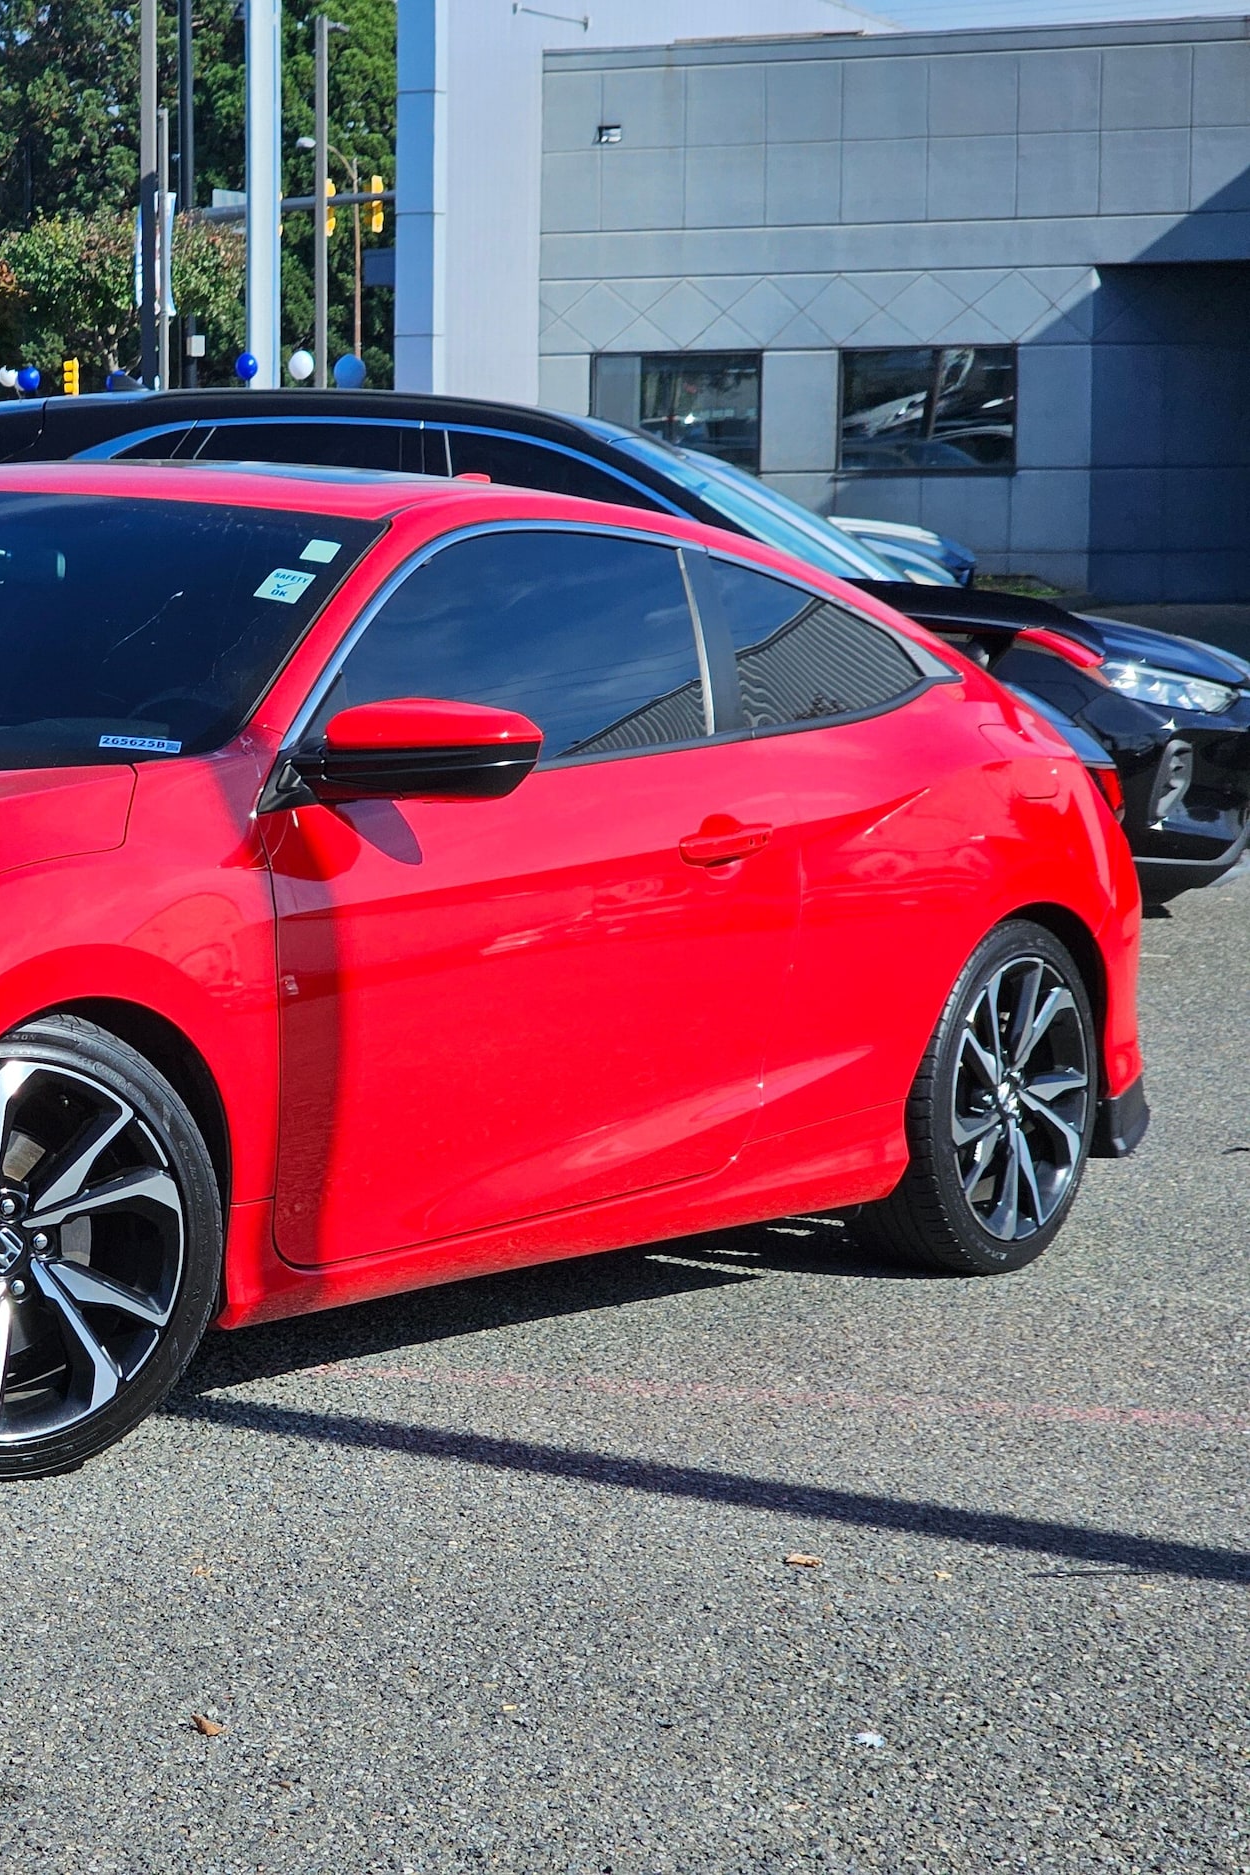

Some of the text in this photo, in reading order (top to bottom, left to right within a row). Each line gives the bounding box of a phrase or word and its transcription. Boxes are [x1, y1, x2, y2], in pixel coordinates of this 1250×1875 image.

[273, 572, 310, 584] SAFETY
[270, 588, 288, 597] OK
[101, 736, 166, 749] 265625B
